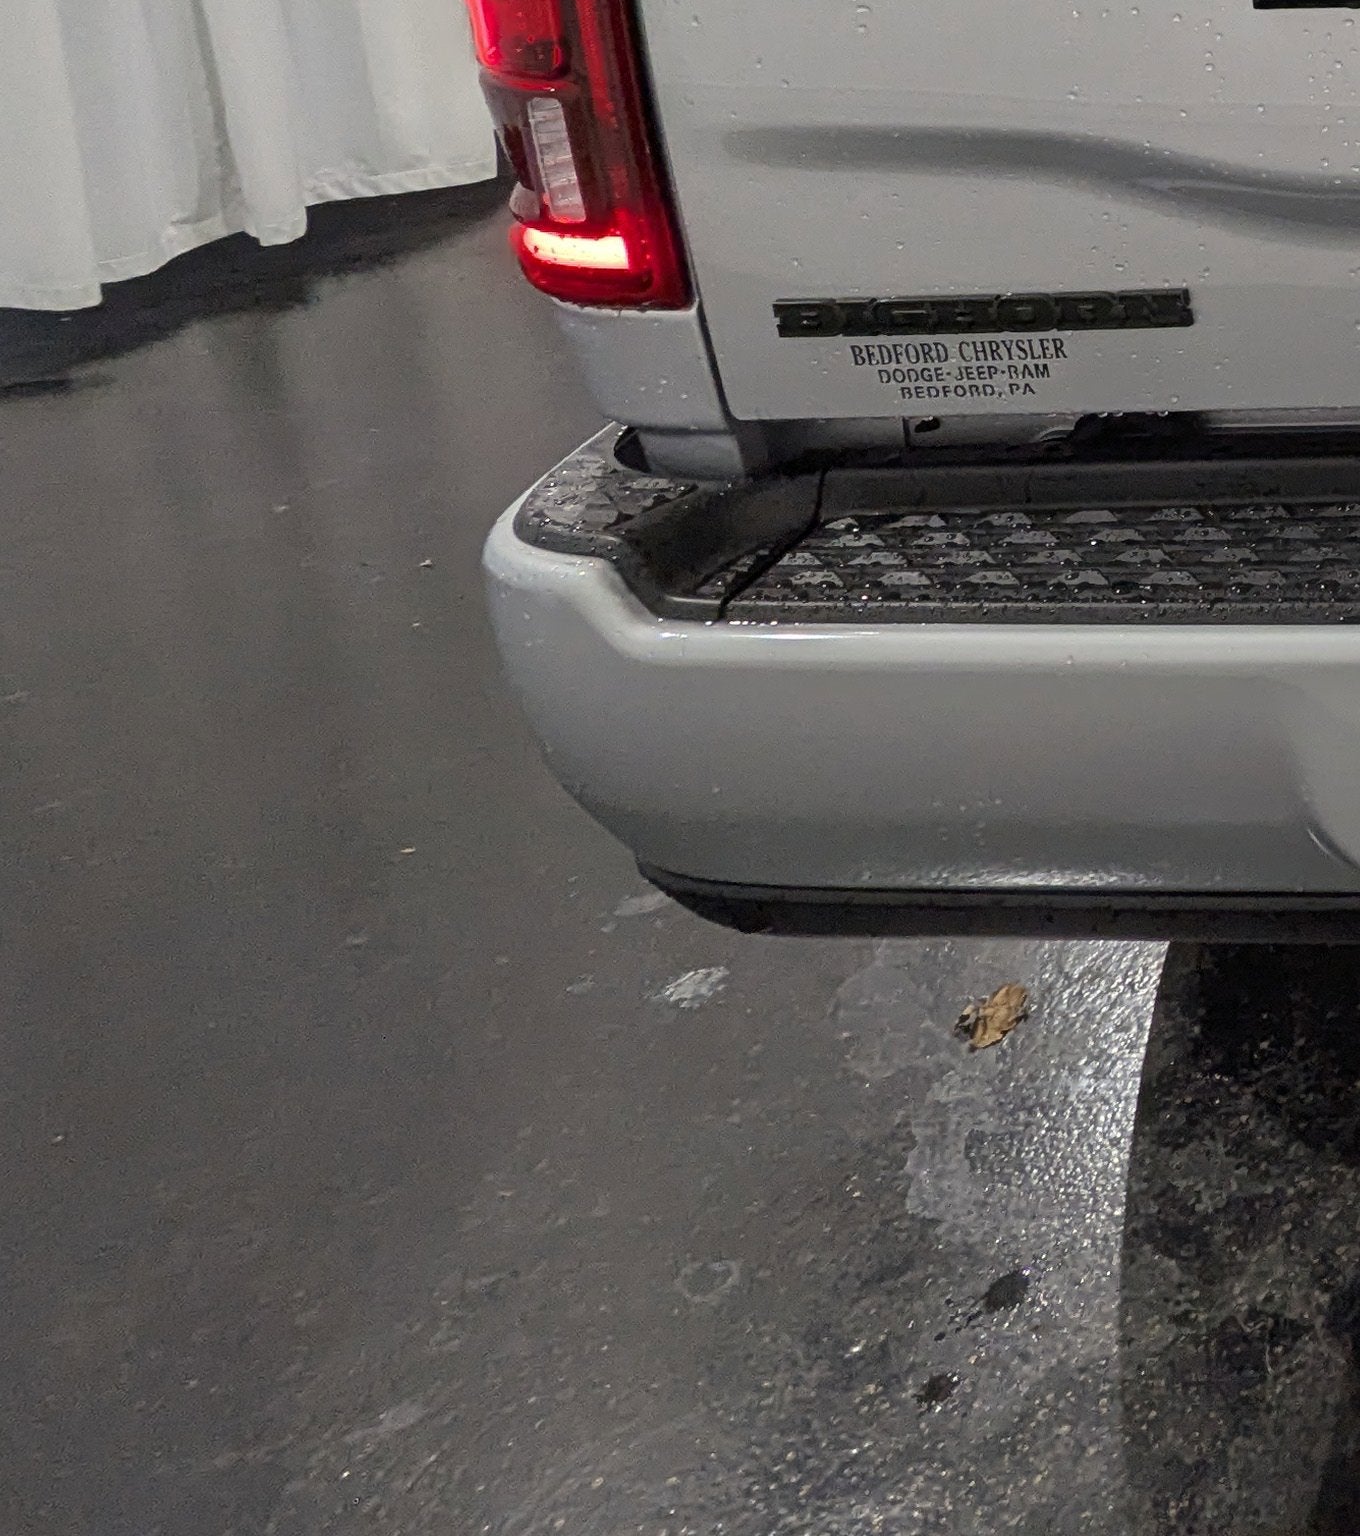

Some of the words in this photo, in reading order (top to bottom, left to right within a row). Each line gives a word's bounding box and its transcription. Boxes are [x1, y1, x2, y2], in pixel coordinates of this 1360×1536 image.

[850, 342, 949, 366] BEDFORD
[958, 337, 1068, 362] CHRYSLER
[900, 384, 1002, 400] BEDFORD,
[1008, 382, 1036, 396] PA
